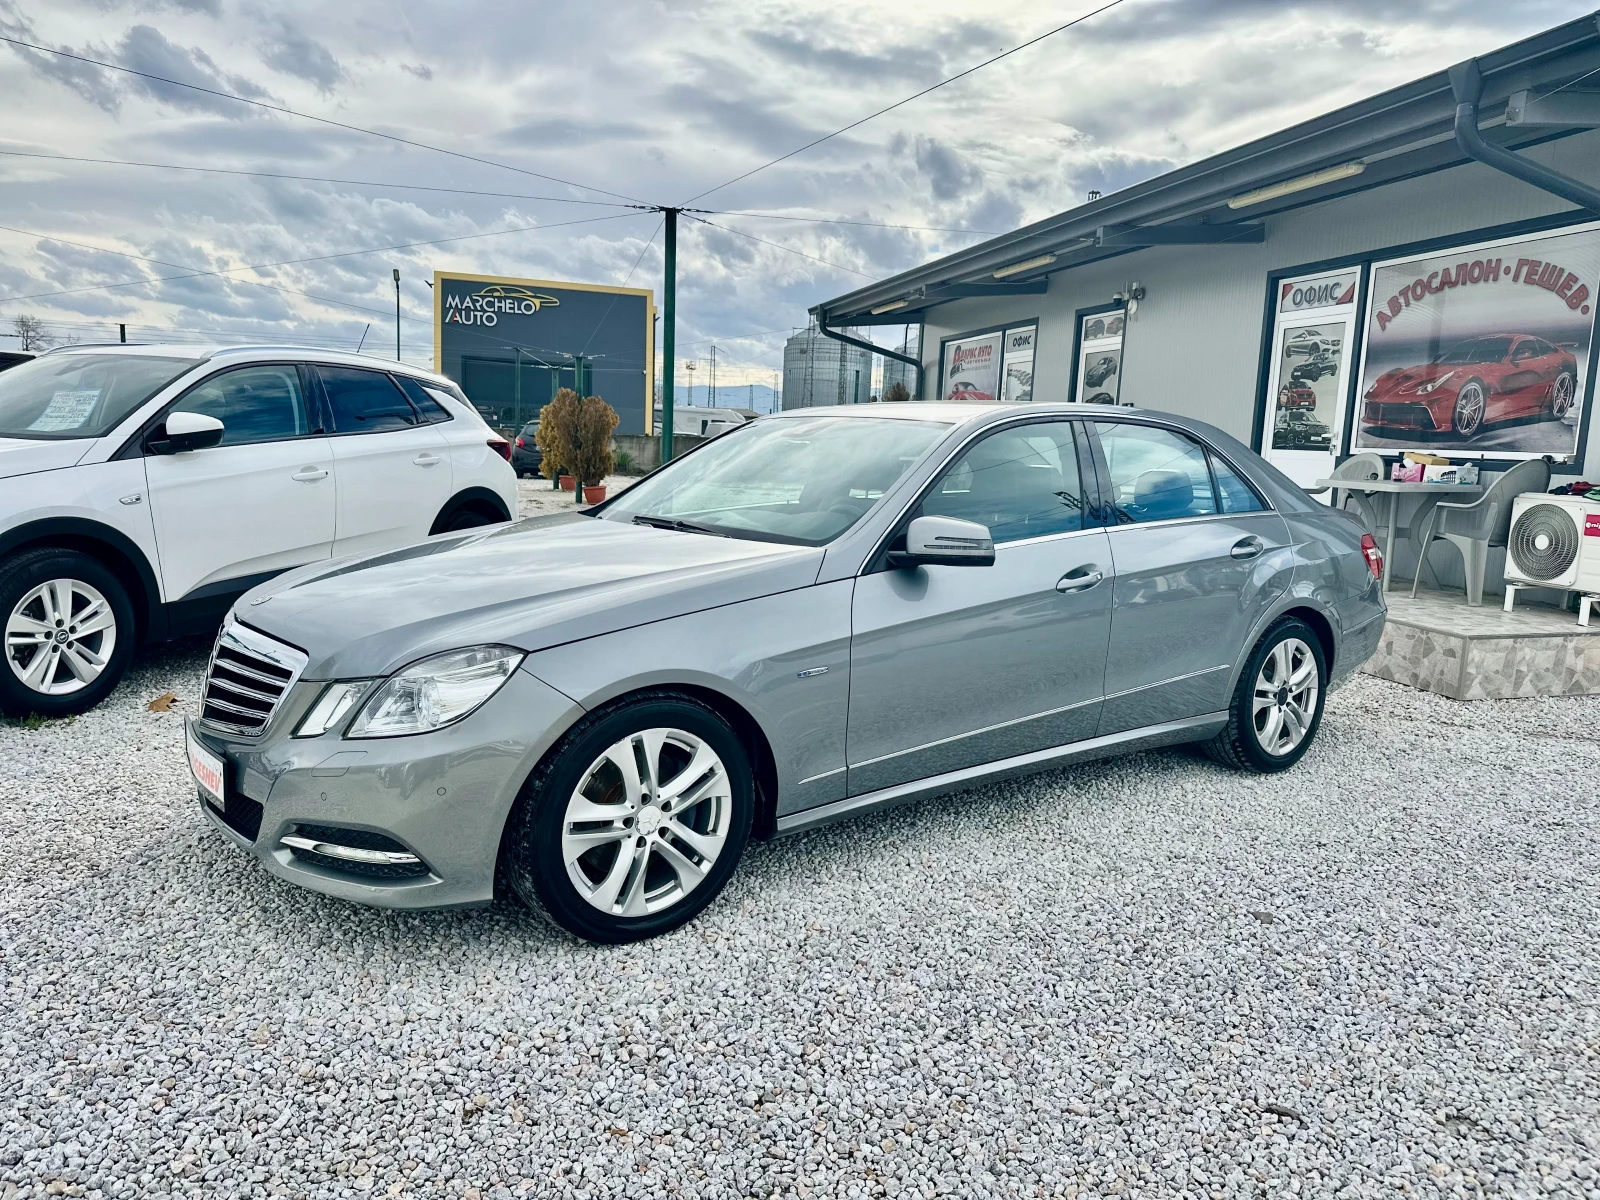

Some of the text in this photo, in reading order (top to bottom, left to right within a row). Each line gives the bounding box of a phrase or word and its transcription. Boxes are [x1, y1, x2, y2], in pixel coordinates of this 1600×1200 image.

[446, 293, 536, 315] MARCHELO
[1292, 282, 1342, 306] ОФИС
[1376, 258, 1589, 331] АВТОСАЛОН ГЕШЕВ
[445, 309, 498, 326] AUTO
[1012, 335, 1032, 347] ОФИС
